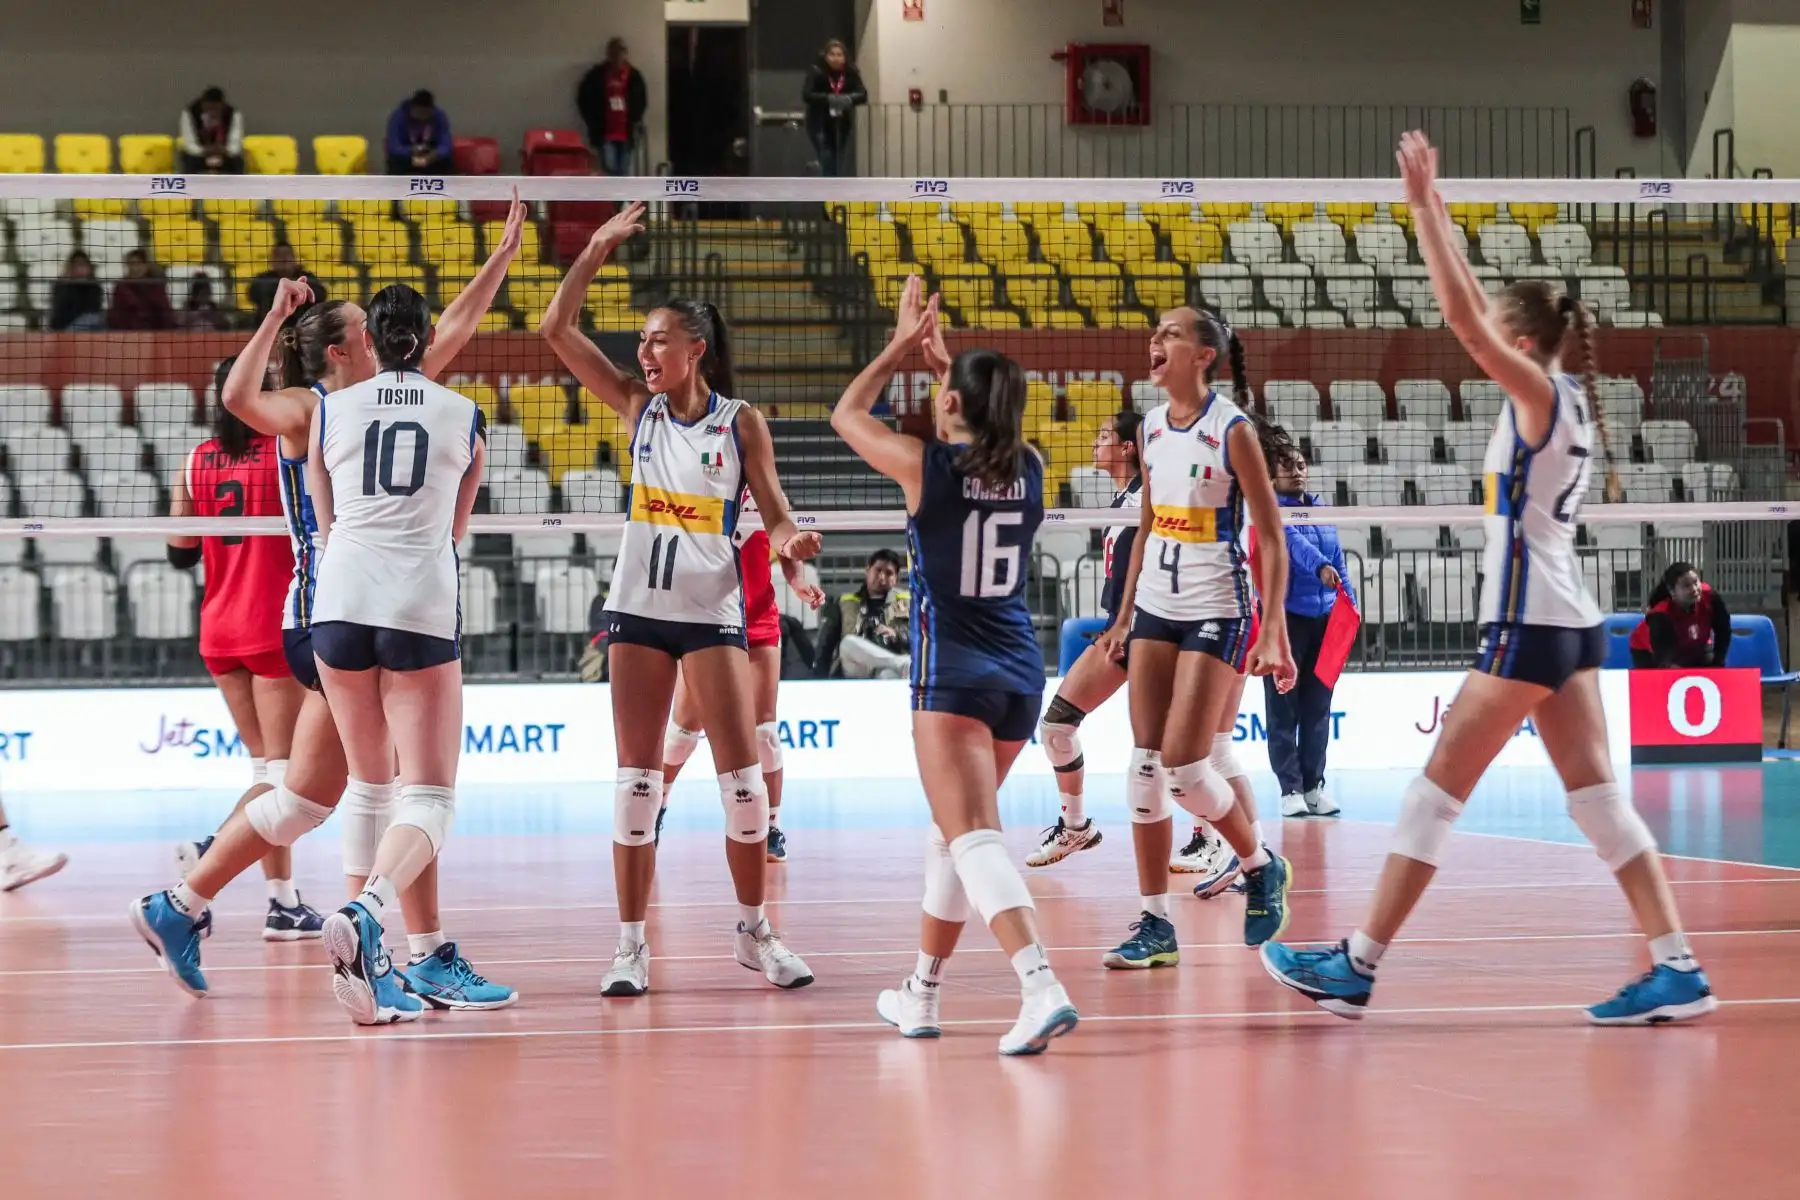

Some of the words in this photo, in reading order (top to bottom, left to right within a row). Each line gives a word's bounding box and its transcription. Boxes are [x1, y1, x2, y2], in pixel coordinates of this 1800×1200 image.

[152, 178, 186, 190] FIVB
[410, 179, 444, 191] FIVB
[665, 180, 699, 192] FIVB
[915, 181, 948, 192] FIVB
[1162, 181, 1194, 193] FIVB
[1640, 182, 1671, 193] FIVB
[377, 388, 424, 405] TOSINI
[363, 420, 429, 496] 10
[215, 480, 245, 546] 2
[648, 499, 699, 520] DHL
[542, 518, 562, 526] FIVB
[797, 516, 816, 524] FIVB
[647, 532, 679, 591] 11
[959, 509, 1023, 597] 16
[1159, 540, 1181, 594] 4
[1667, 675, 1722, 737] 0
[464, 724, 566, 754] MART
[777, 720, 840, 749] ART
